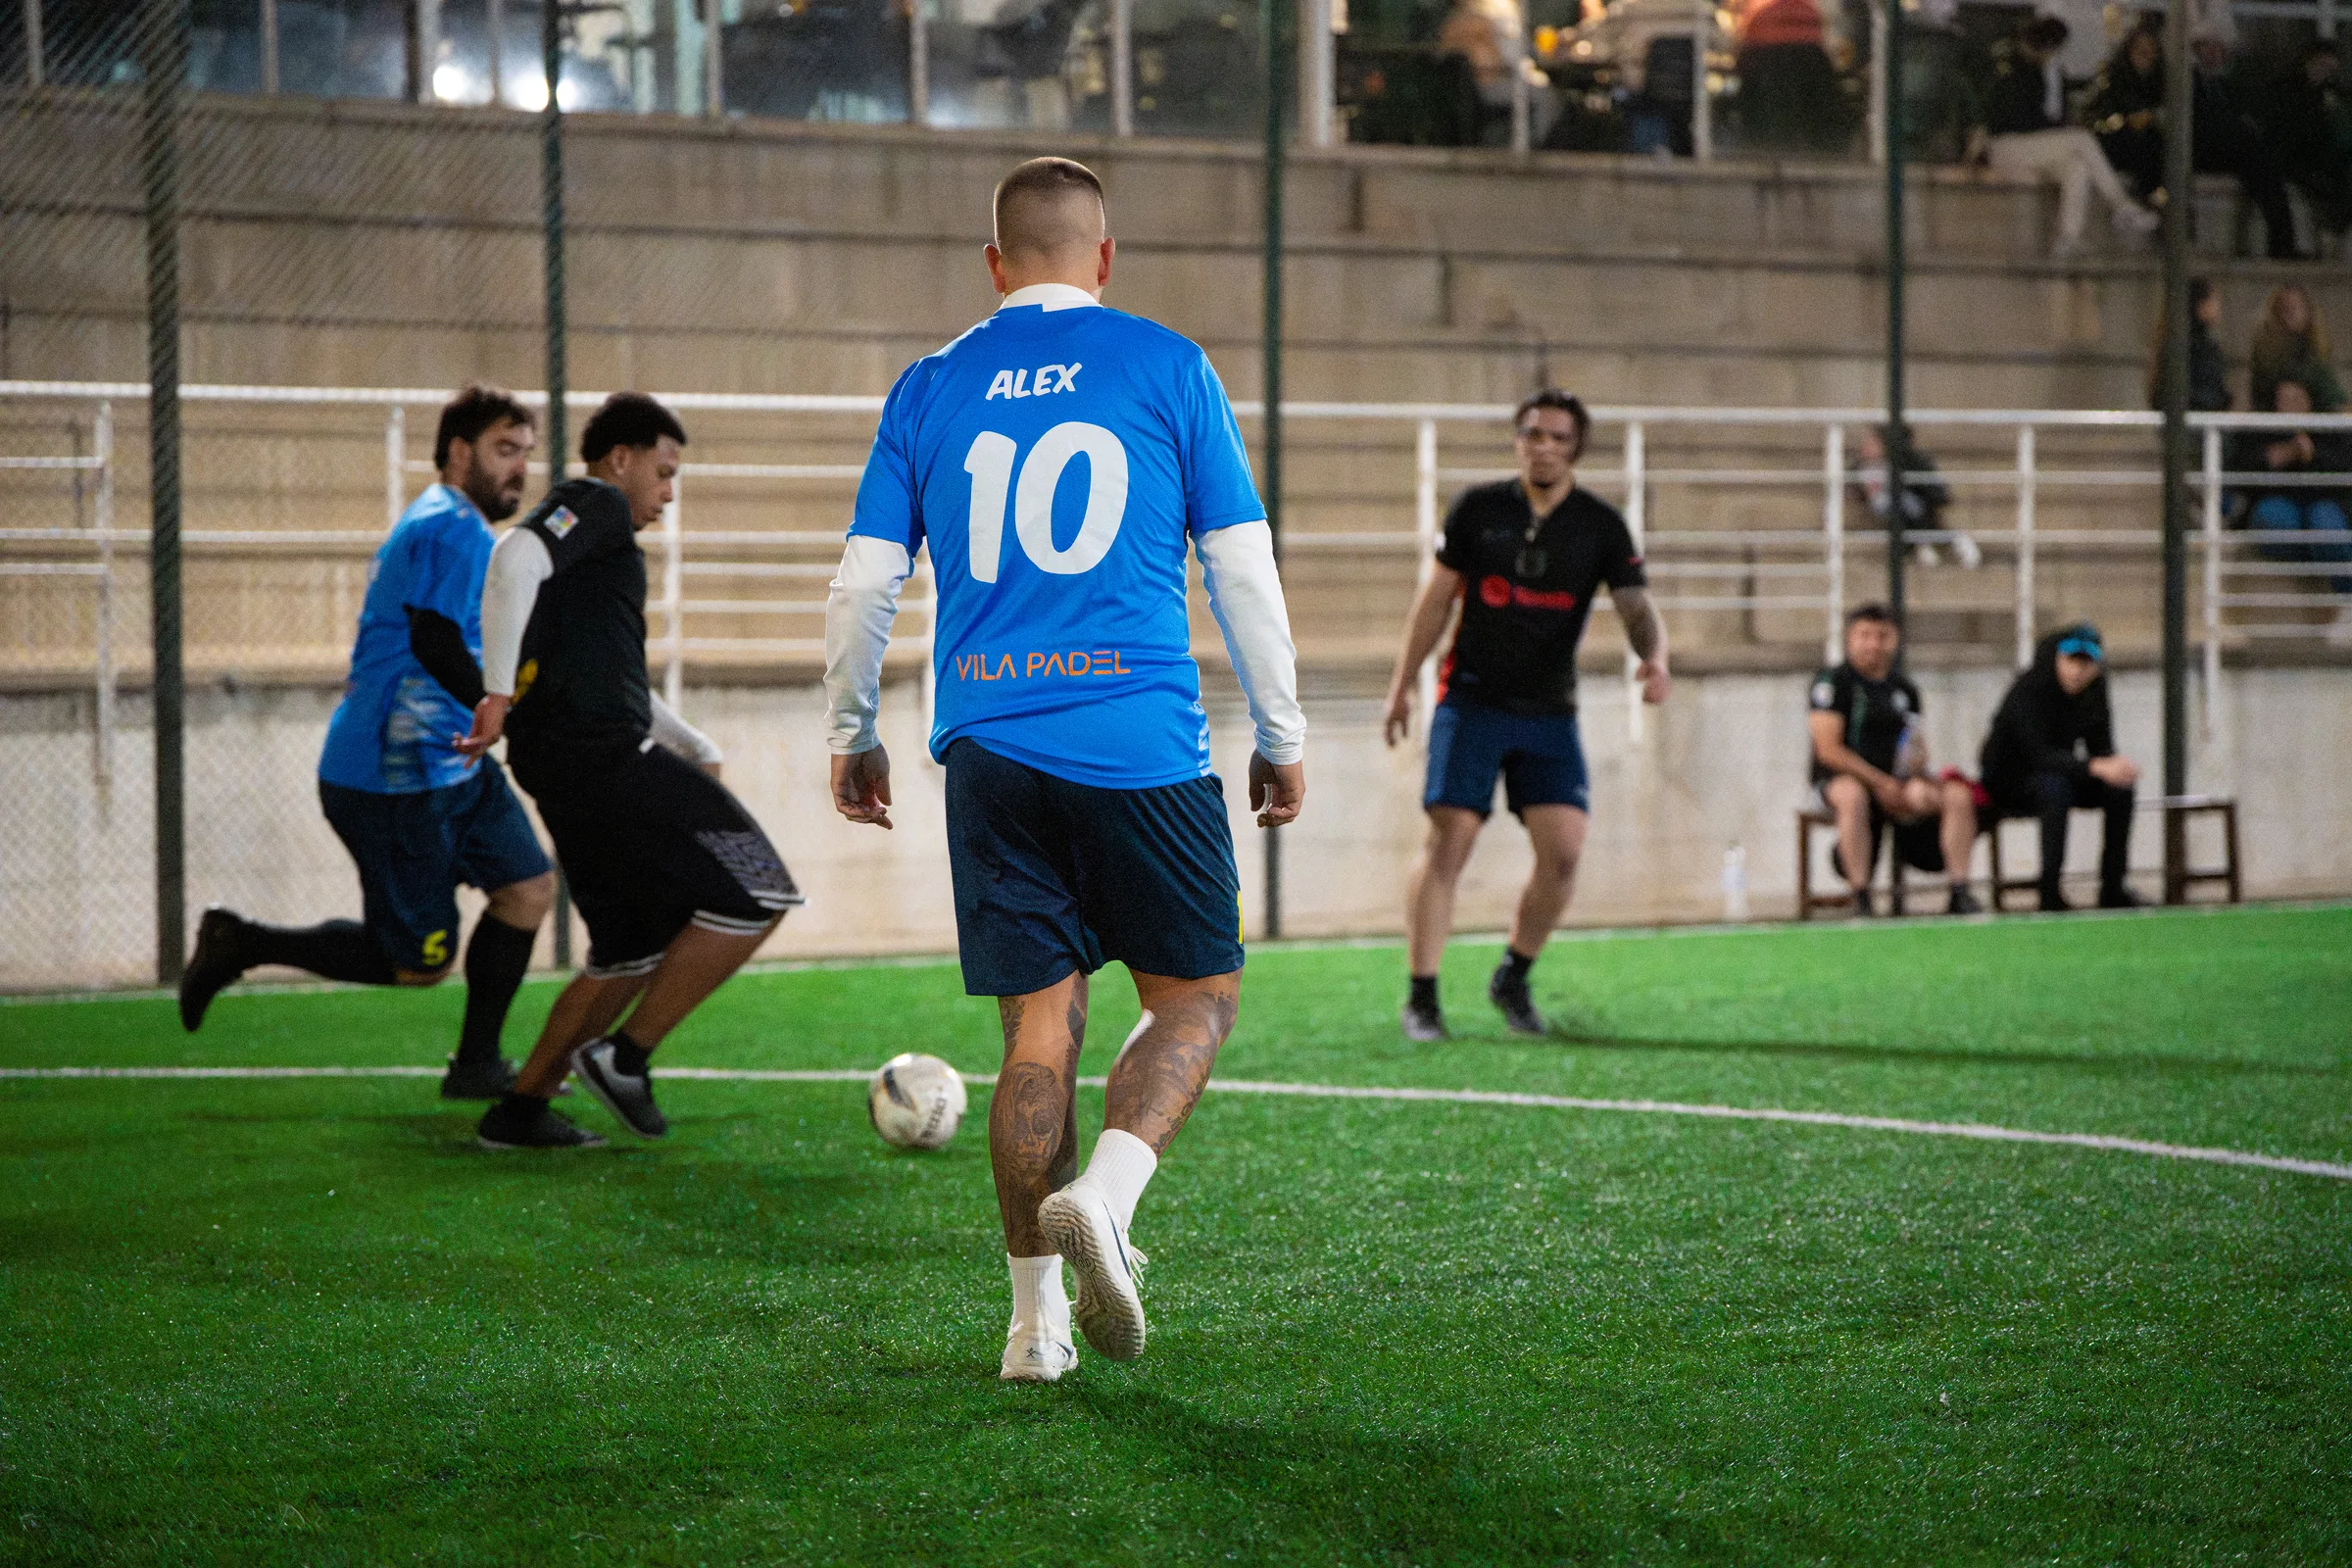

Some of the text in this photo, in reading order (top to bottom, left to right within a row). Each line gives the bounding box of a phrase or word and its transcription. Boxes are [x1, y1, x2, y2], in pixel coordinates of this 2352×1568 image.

[985, 362, 1082, 400] ALEX
[963, 420, 1128, 583] 10
[956, 650, 1131, 681] VILA PADEL
[422, 929, 447, 965] 5
